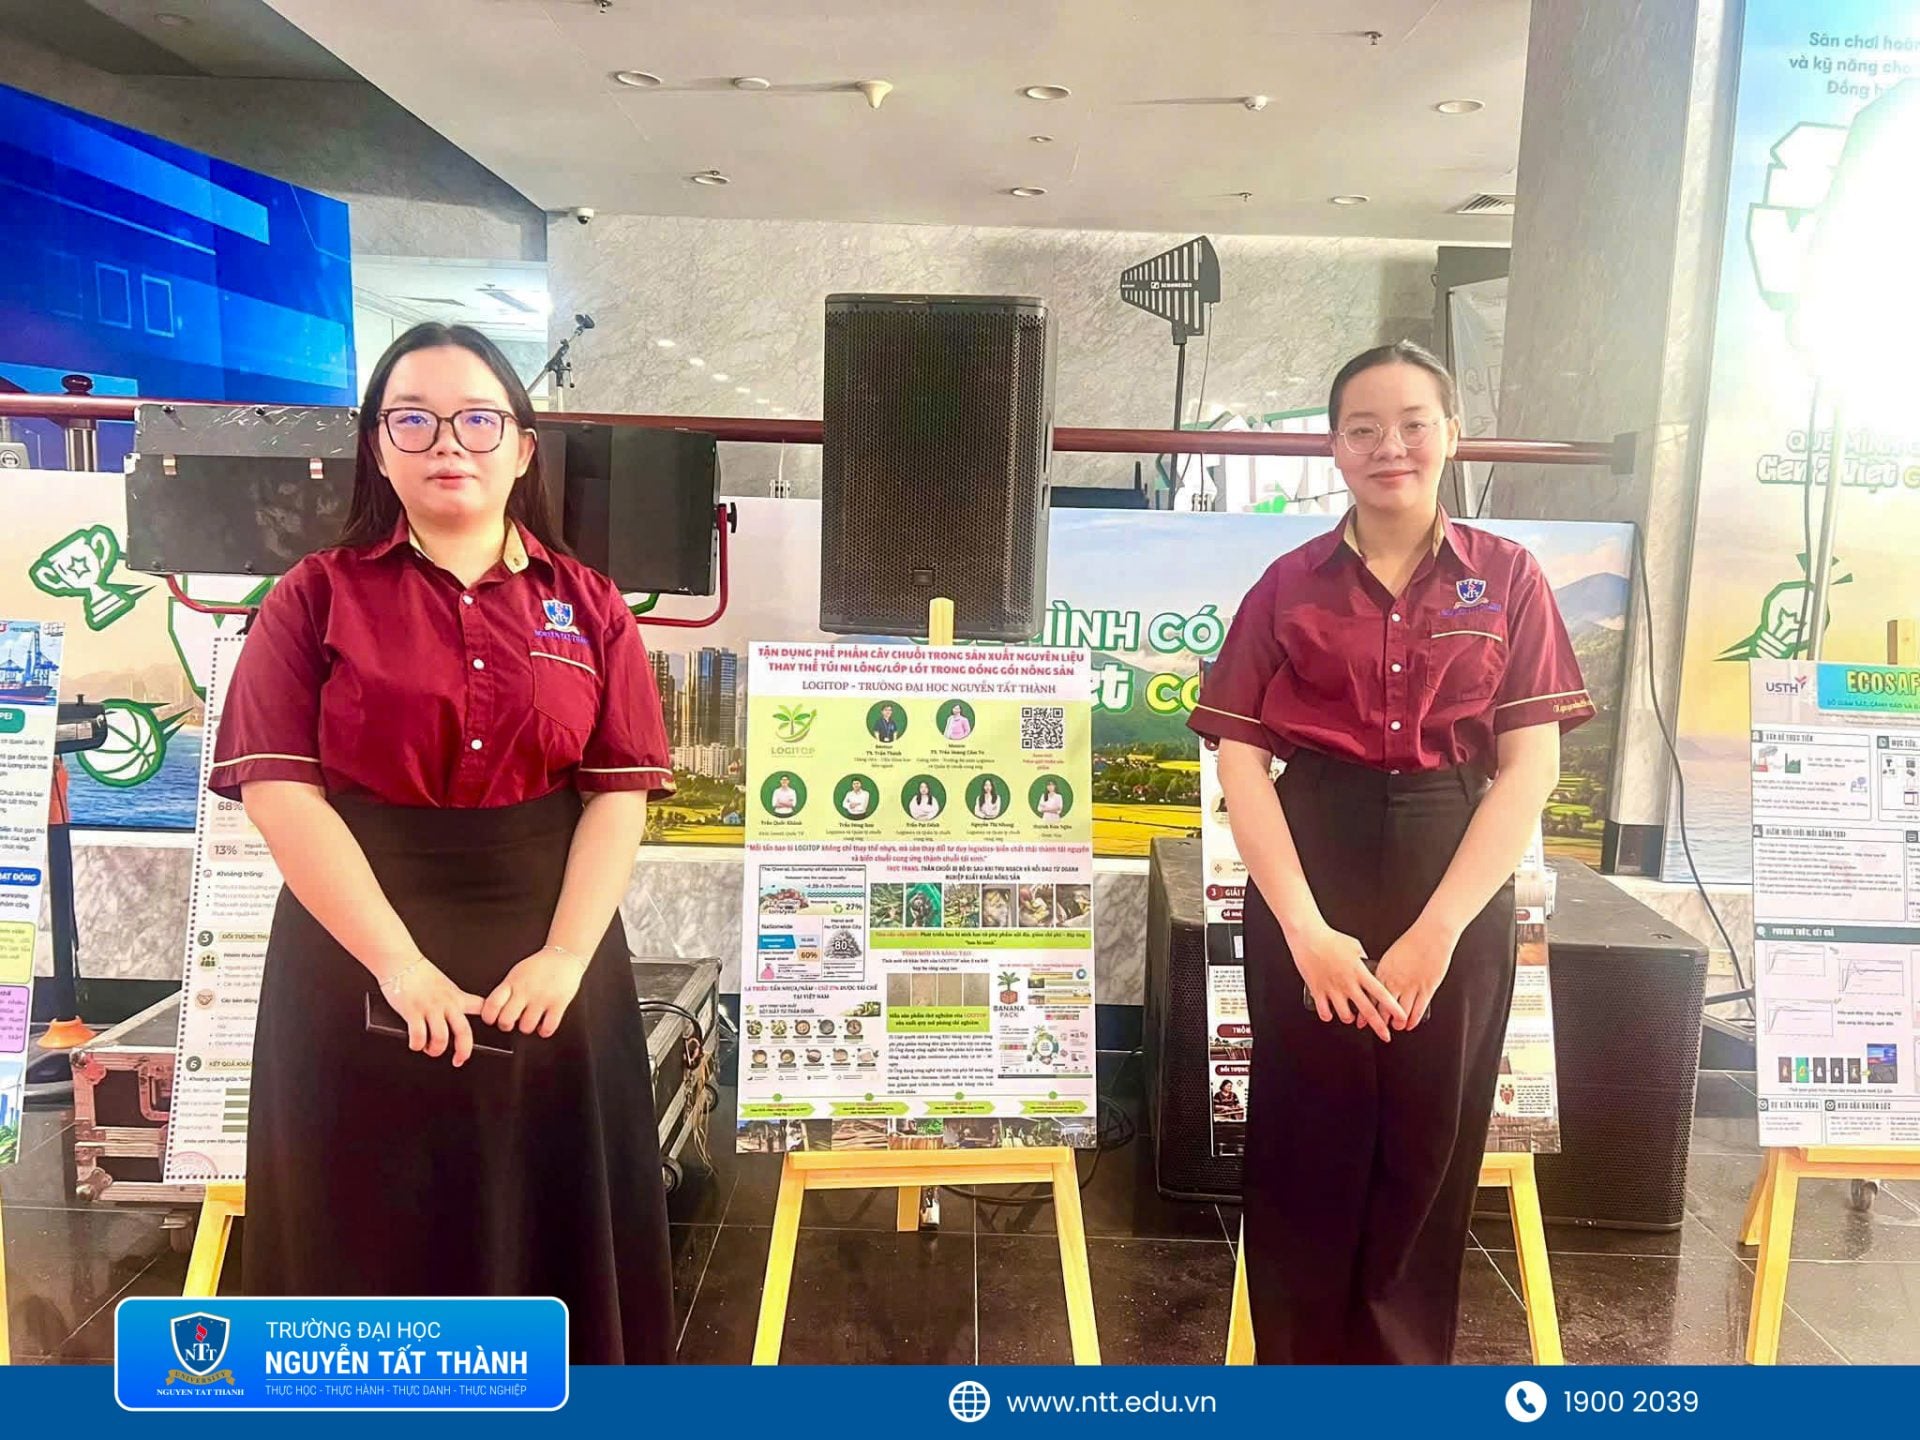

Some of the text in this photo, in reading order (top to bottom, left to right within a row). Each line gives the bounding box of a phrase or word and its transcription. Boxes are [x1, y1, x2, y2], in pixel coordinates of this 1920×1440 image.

[1809, 32, 1879, 49] Sân chơi
[1789, 55, 1808, 69] và
[1813, 57, 1832, 73] kỹ
[1837, 59, 1877, 76] năng
[1042, 599, 1223, 655] ÌNH CÓ
[802, 680, 1057, 695] LOGITOP TRƯỜNG ĐẠI HỌC NGUYỄN TẤT THÀNH
[1766, 682, 1799, 693] USTH
[771, 746, 816, 756] LOGITOP
[218, 801, 243, 811] 68%
[214, 845, 238, 855] 13%
[795, 844, 820, 852] LOGITOP
[846, 903, 863, 911] 27%
[202, 934, 210, 942] 3
[834, 941, 848, 951] 80
[800, 952, 818, 960] 60%
[191, 1060, 198, 1069] 6
